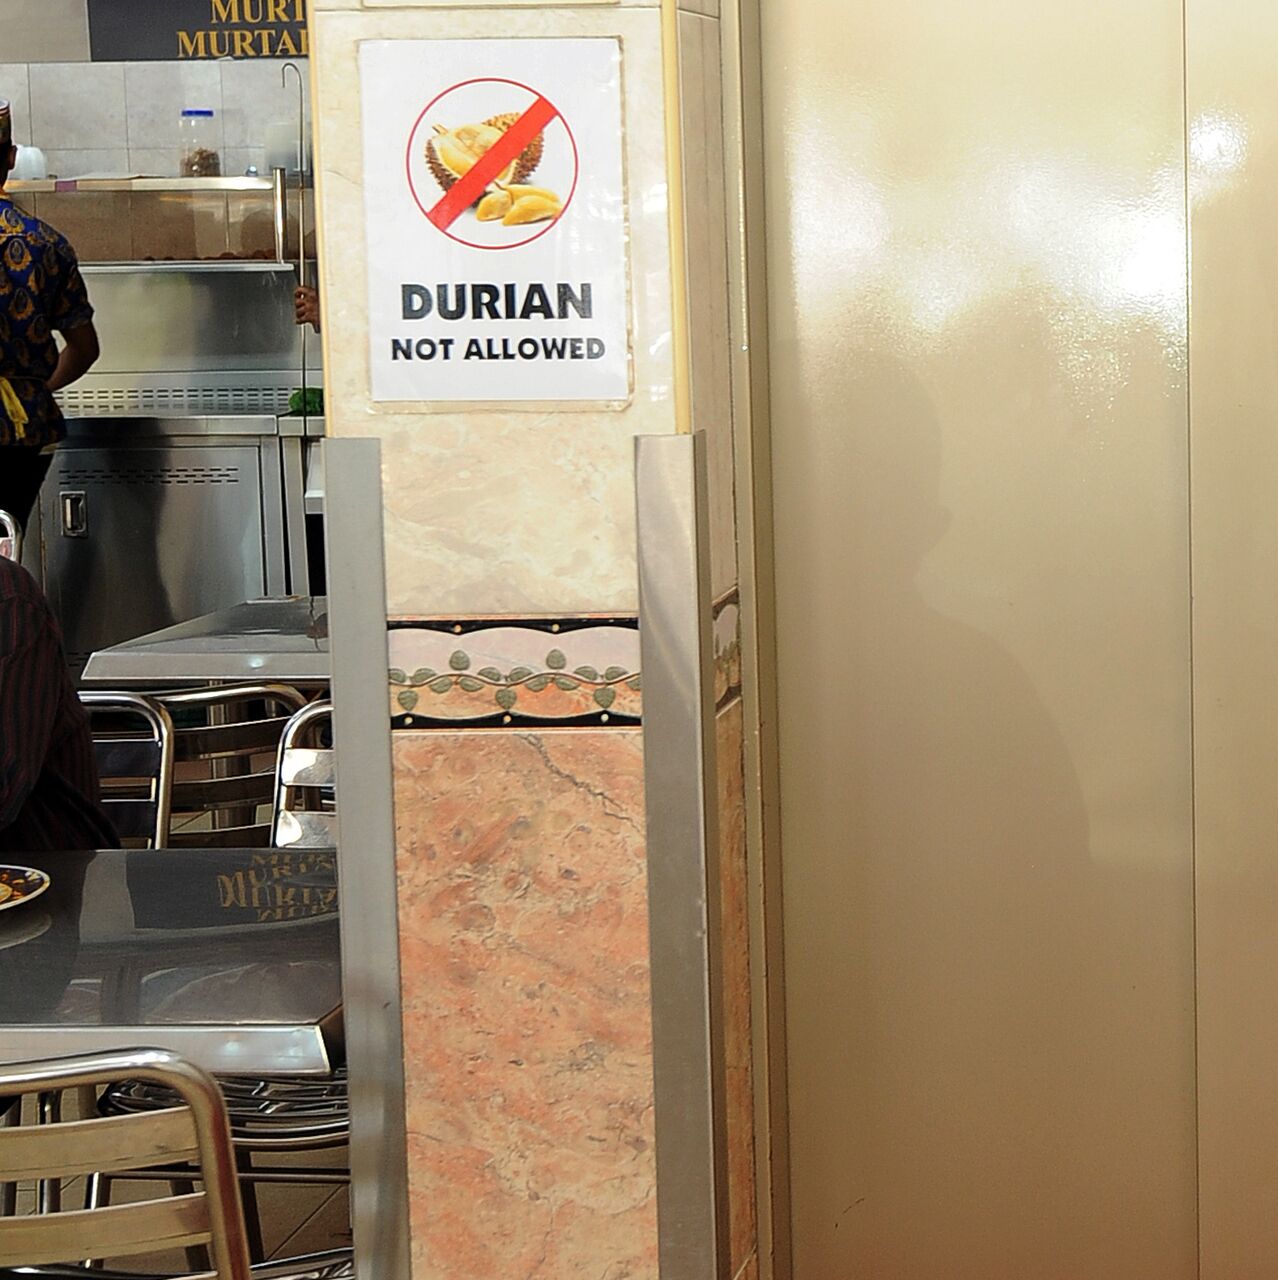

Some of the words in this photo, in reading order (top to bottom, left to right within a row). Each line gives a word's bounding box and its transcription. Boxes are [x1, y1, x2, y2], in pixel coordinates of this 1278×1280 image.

[400, 282, 593, 321] DURIAN
[392, 338, 454, 361] NOT
[464, 337, 605, 361] ALLOWED
